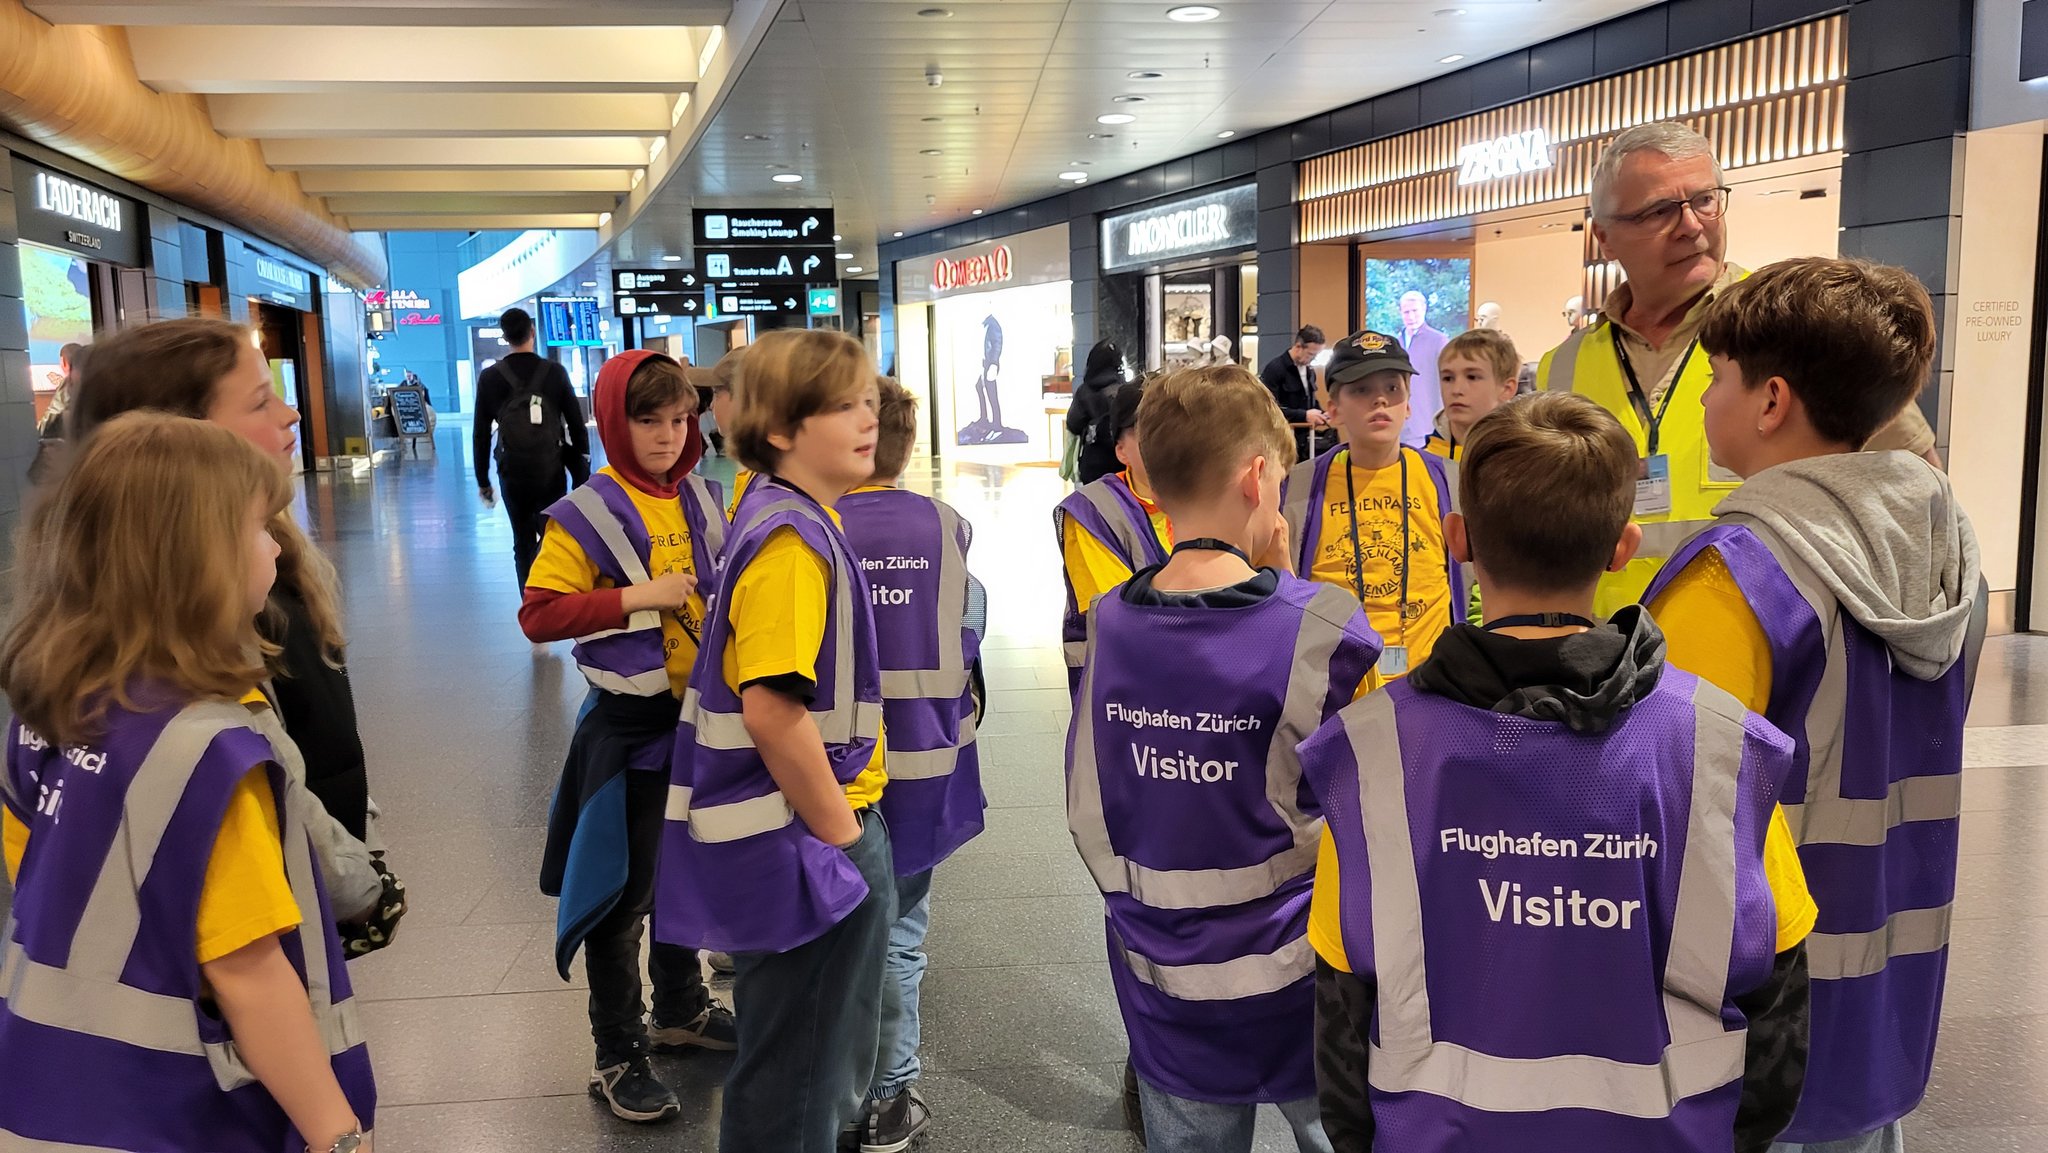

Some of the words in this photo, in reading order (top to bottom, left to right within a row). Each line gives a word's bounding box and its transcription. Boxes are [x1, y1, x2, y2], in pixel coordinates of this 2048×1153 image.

[1458, 128, 1551, 185] ZEGNA
[38, 172, 121, 232] LÄDERACH
[731, 217, 783, 227] Raucherzone
[1128, 204, 1230, 255] MONCLER
[68, 230, 102, 250] SWITZERLAND
[731, 228, 767, 238] Smoking
[768, 228, 798, 238] Lounge
[777, 255, 793, 275] A
[949, 253, 995, 288] OMEGA
[651, 302, 659, 312] A
[1973, 301, 2019, 312] CERTIFIED
[1966, 316, 2022, 327] PRE-OWNED
[1977, 331, 2012, 341] LUXURY
[1330, 496, 1422, 516] FEIENPASS
[886, 556, 929, 570] Zürich
[871, 584, 914, 605] itor
[1105, 703, 1192, 729] Flughafen
[1196, 712, 1262, 734] Zürich
[1131, 742, 1239, 784] Visitor
[1440, 827, 1578, 860] Flughafen
[1583, 832, 1658, 859] Zürih
[1478, 878, 1641, 930] Visitor
